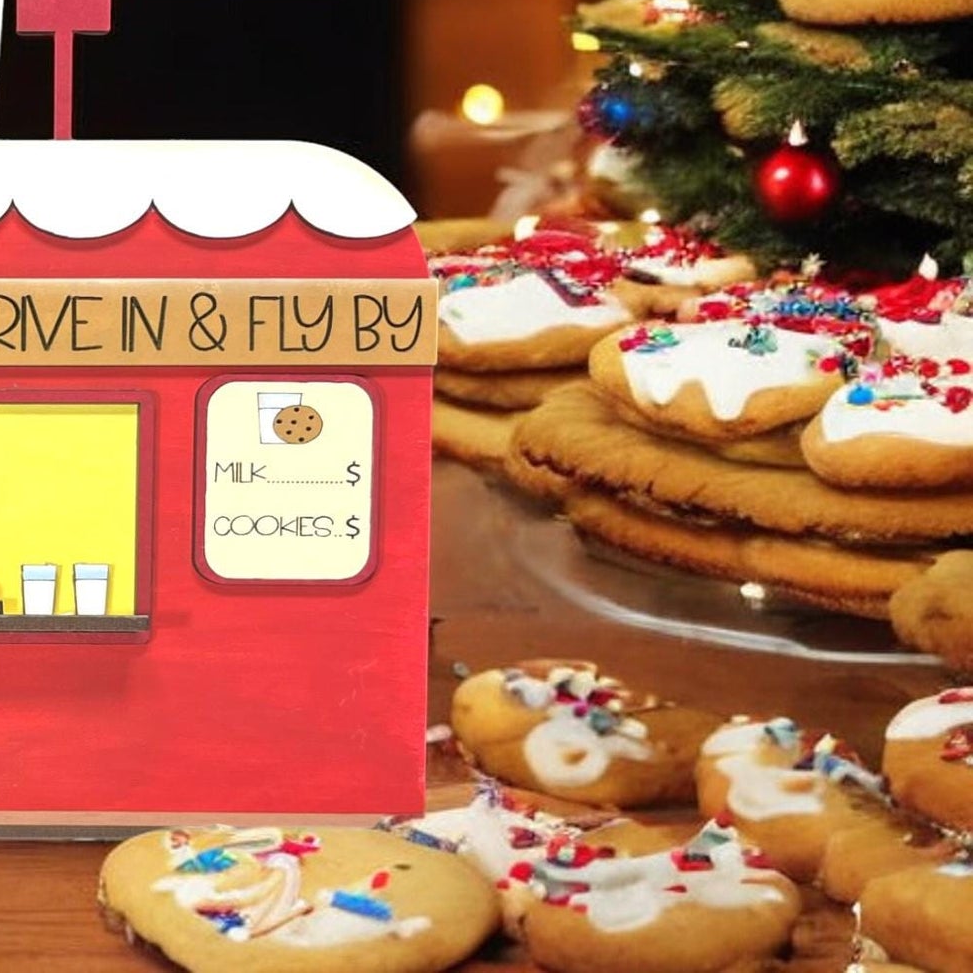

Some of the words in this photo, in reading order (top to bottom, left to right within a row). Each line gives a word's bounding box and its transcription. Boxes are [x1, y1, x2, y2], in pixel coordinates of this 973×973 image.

[121, 295, 167, 353] IN
[188, 292, 228, 351] &
[249, 295, 333, 352] FLY
[353, 294, 424, 353] BY
